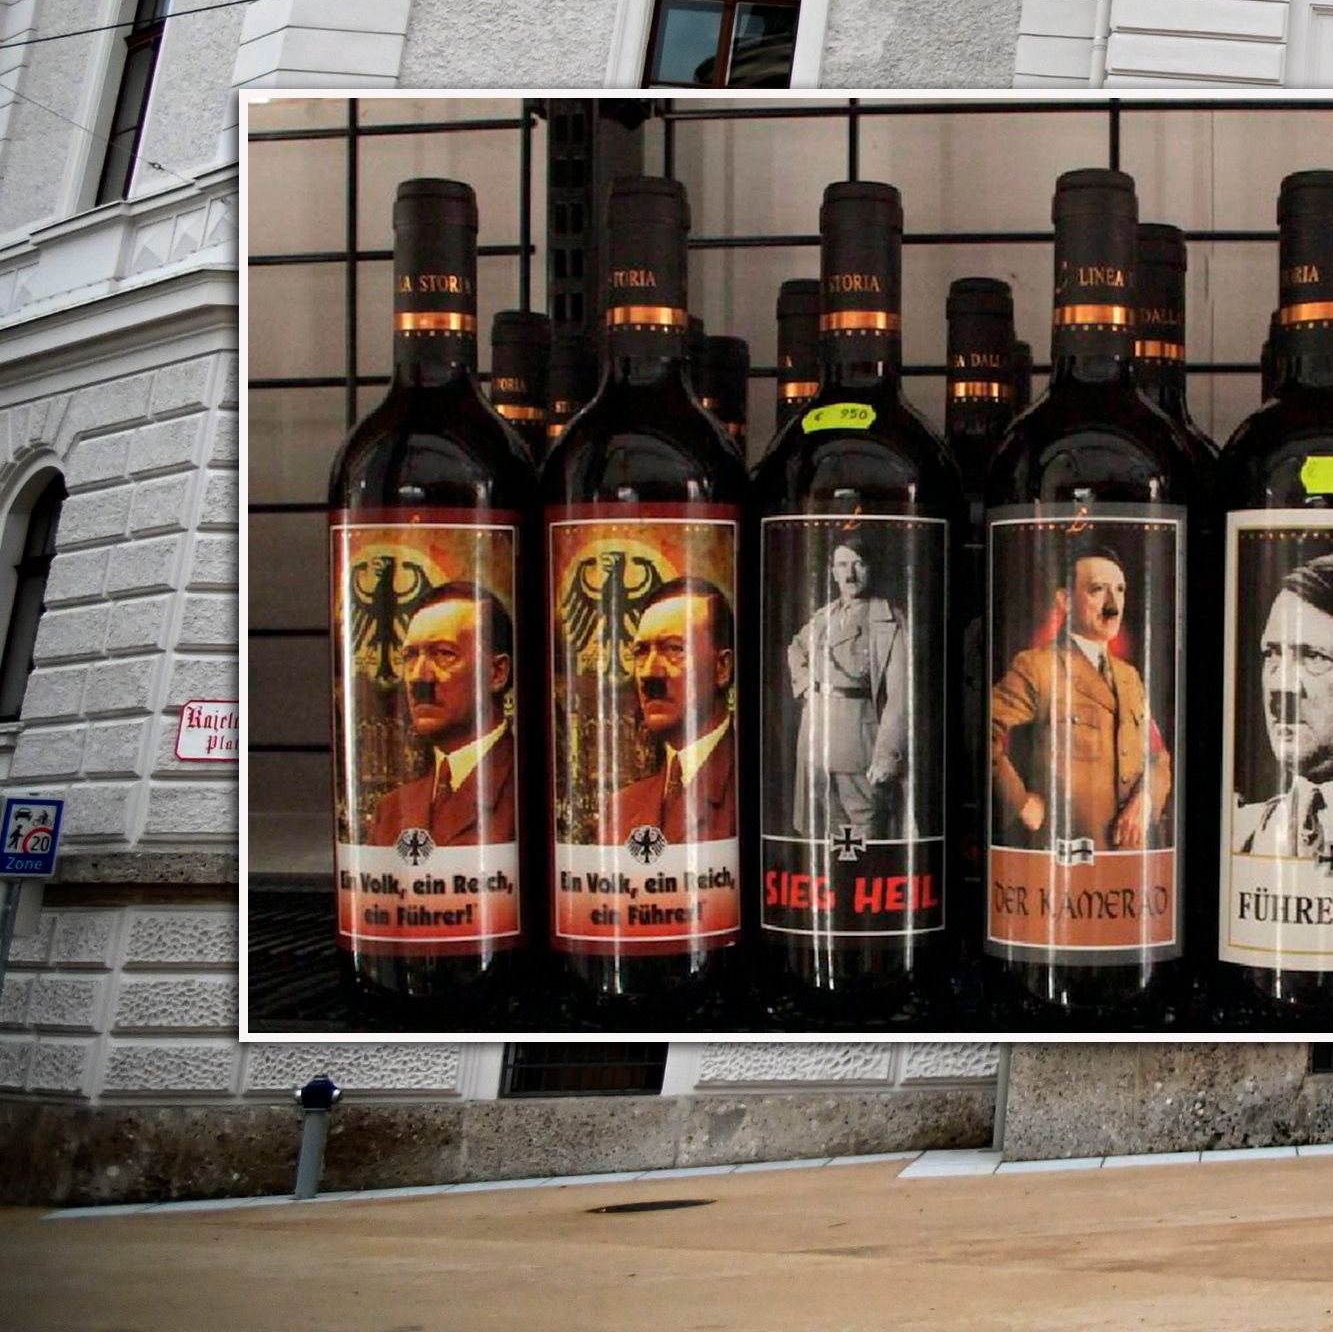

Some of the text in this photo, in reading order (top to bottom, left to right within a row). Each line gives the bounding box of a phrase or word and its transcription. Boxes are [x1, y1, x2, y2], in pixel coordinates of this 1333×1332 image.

[1079, 267, 1125, 287] LINEA
[31, 835, 51, 852] 20
[6, 856, 43, 870] Zone
[360, 872, 406, 899] Volk,
[413, 874, 446, 895] ein
[586, 872, 639, 899] Volk,
[644, 872, 678, 893] ein
[765, 870, 939, 914] SIEG HEIL
[994, 881, 1029, 917] DER
[364, 903, 473, 927] ein Führer!
[591, 903, 621, 926] ein
